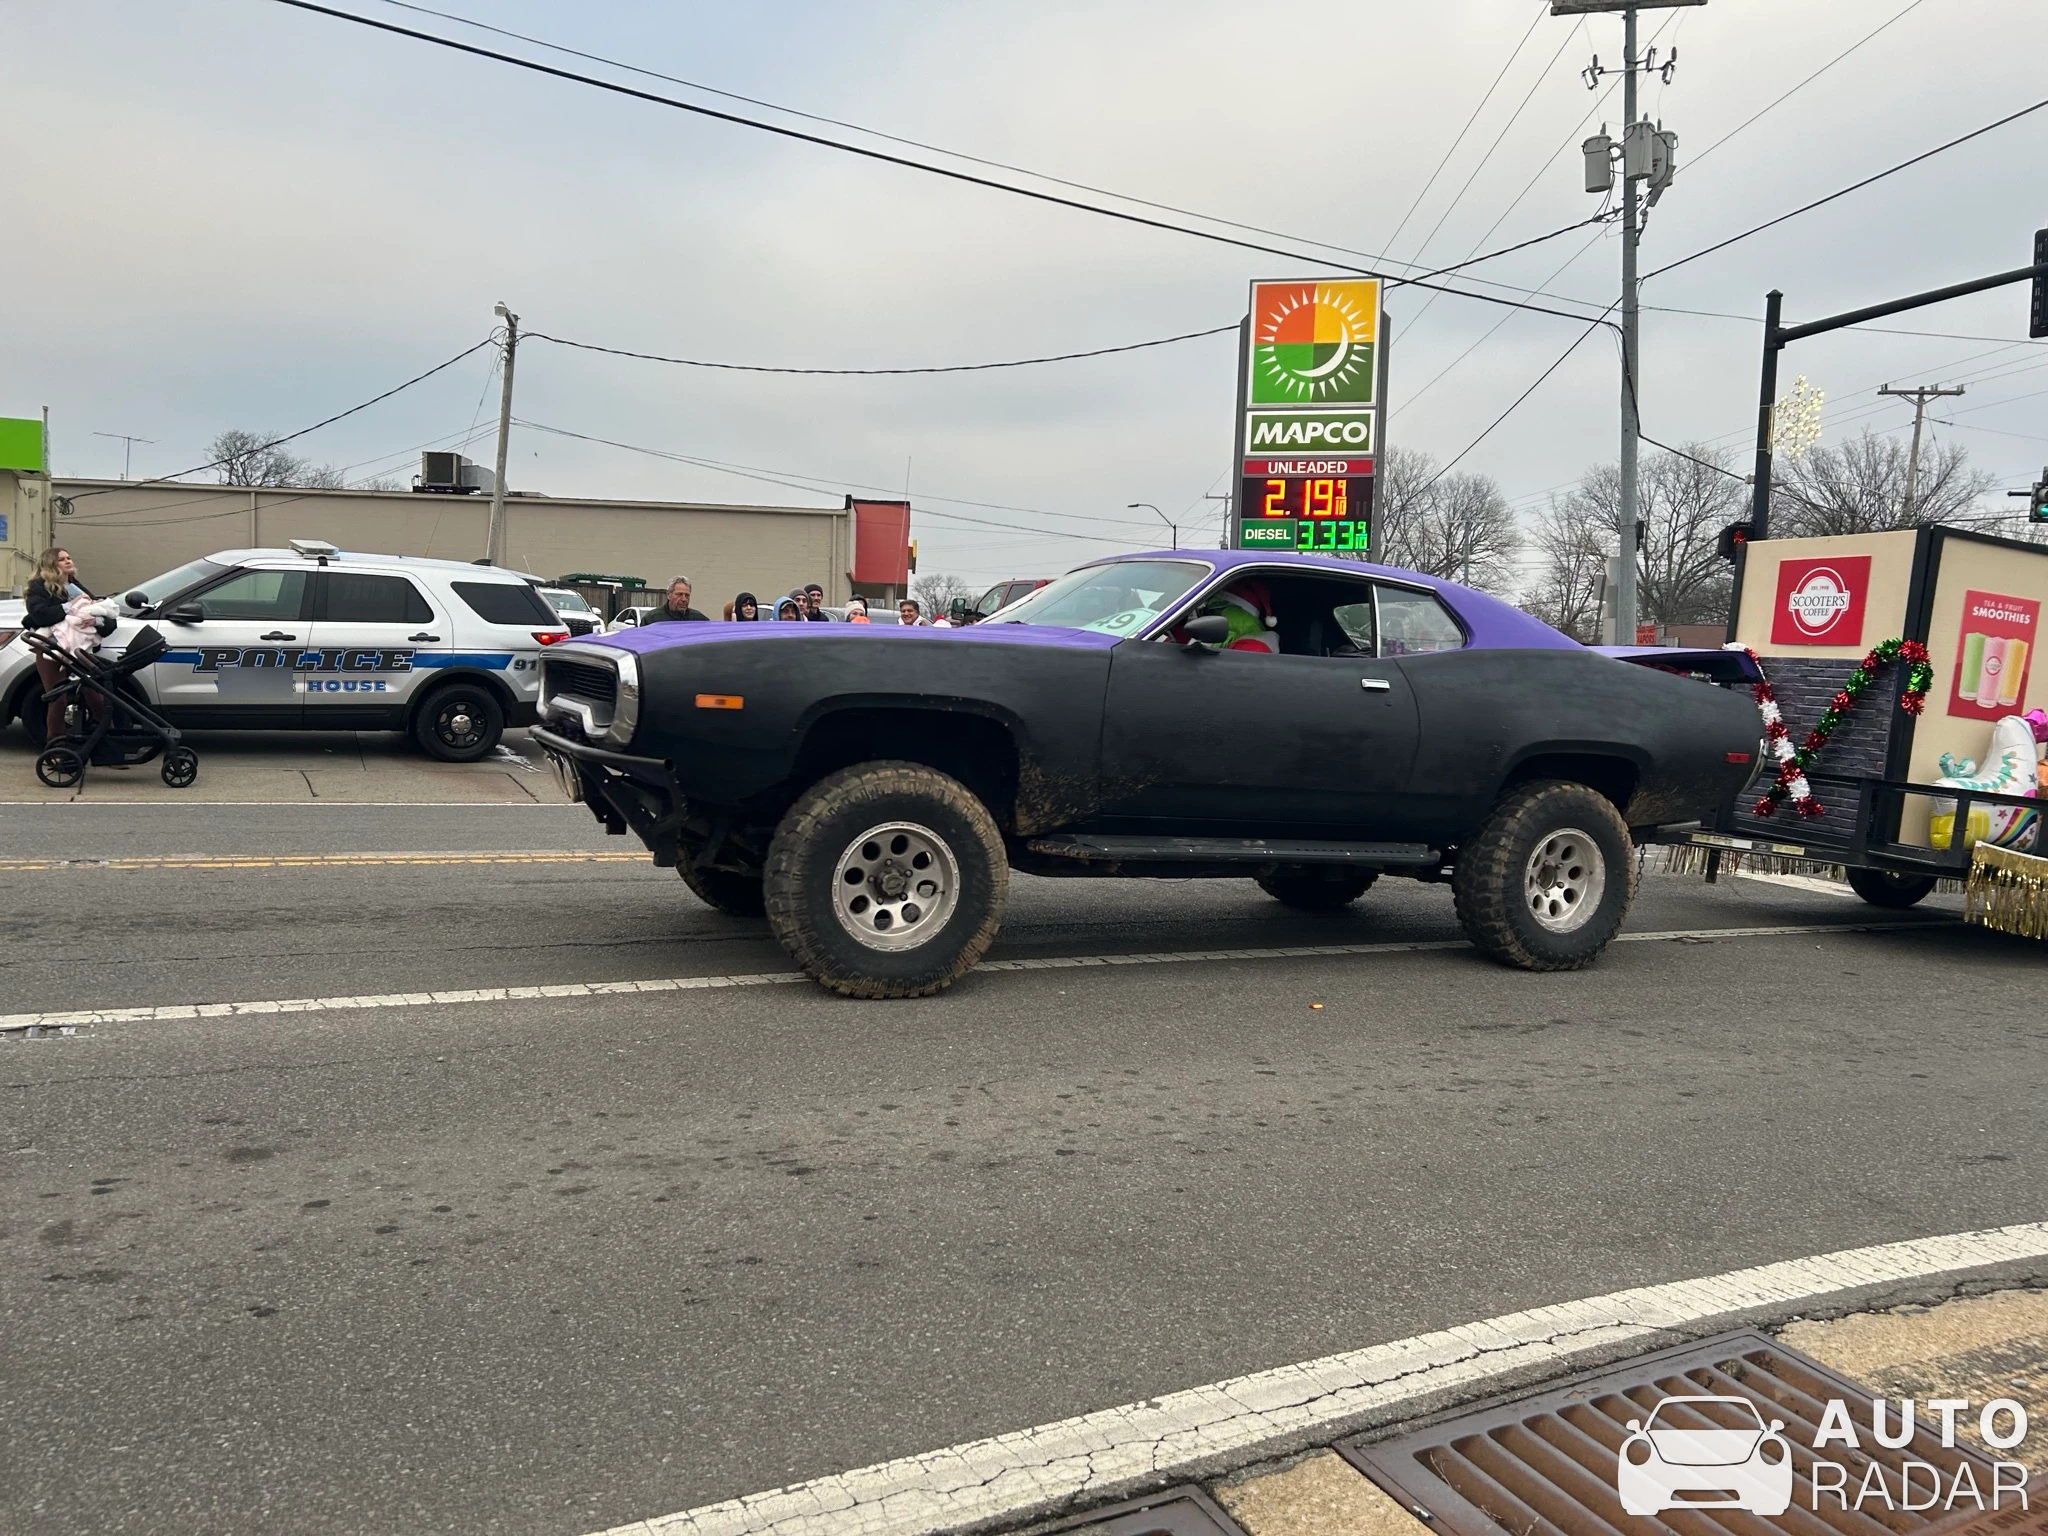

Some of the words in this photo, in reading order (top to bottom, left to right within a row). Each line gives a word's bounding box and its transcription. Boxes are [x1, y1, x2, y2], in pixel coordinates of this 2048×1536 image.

[1253, 421, 1368, 444] MAPCO
[1268, 461, 1348, 474] UNLEADED
[1265, 479, 1333, 516] 2.19
[1245, 529, 1291, 540] DIESEL
[1792, 595, 1846, 607] SCOOTER'S
[1803, 608, 1830, 617] COFFEE
[2005, 604, 2024, 612] FRUIT
[1972, 606, 2031, 625] SMOOTHIES
[193, 647, 416, 673] POLICE
[307, 680, 387, 693] HOUSE
